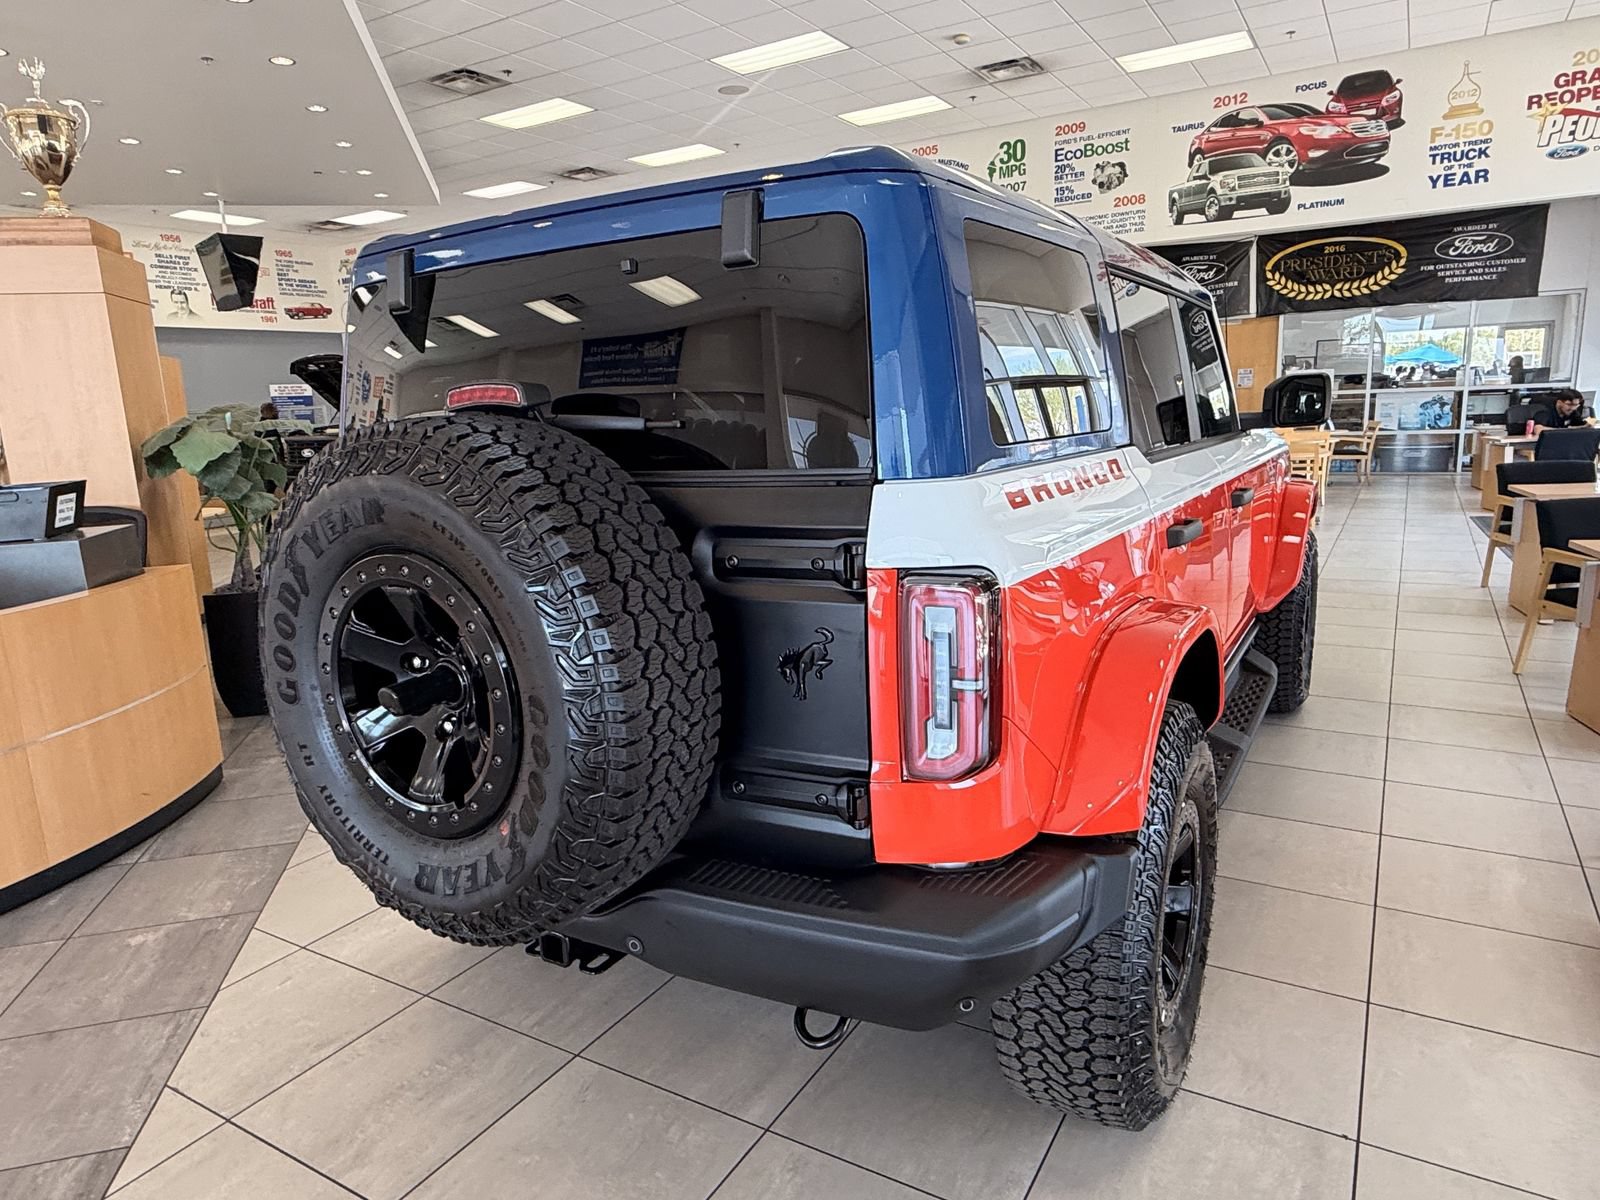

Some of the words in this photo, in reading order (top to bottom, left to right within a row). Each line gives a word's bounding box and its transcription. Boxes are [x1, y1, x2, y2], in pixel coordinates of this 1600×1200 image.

[1295, 80, 1328, 93] FOCUS
[1213, 92, 1248, 109] 2012
[1451, 88, 1478, 100] 2012
[1055, 122, 1086, 136] 2009
[1172, 121, 1205, 133] TAURUS
[1430, 119, 1494, 144] F-150
[1055, 138, 1078, 146] FORD'S
[1079, 128, 1131, 142] FUEL-EFFICIENT
[999, 139, 1026, 164] 30
[1055, 138, 1130, 162] EcoBoost
[1429, 142, 1460, 152] MOTOR
[1462, 138, 1492, 148] TREND
[1429, 146, 1490, 165] TRUCK
[938, 159, 969, 170] MUSTANG
[999, 163, 1026, 179] MPG
[1055, 163, 1075, 174] 20%
[1458, 162, 1474, 170] THE
[1054, 171, 1085, 181] BETTER
[1428, 168, 1489, 189] YEAR
[1054, 192, 1092, 203] REDUCED
[1055, 185, 1074, 196] 15%
[1114, 194, 1146, 207] 2008
[1298, 198, 1345, 211] PLATINUM
[1107, 216, 1136, 224] LIQUIDITY
[1111, 209, 1146, 218] DOWNTURN
[1453, 224, 1487, 232] AWARDED
[1449, 235, 1499, 255] Ford
[1280, 249, 1395, 272] PRESIDENT'S
[1436, 261, 1485, 270] OUTSTANDING
[1486, 258, 1526, 266] CUSTOMER
[1184, 265, 1216, 281] Ford
[1306, 265, 1365, 281] AWARD
[1445, 274, 1498, 283] PERFORMANCE
[1208, 281, 1238, 290] CUSTOMER
[1002, 458, 1125, 510] BRONCO
[273, 497, 386, 705] GOODYEAR
[297, 741, 315, 767] RT
[316, 784, 391, 867] TERRITORY
